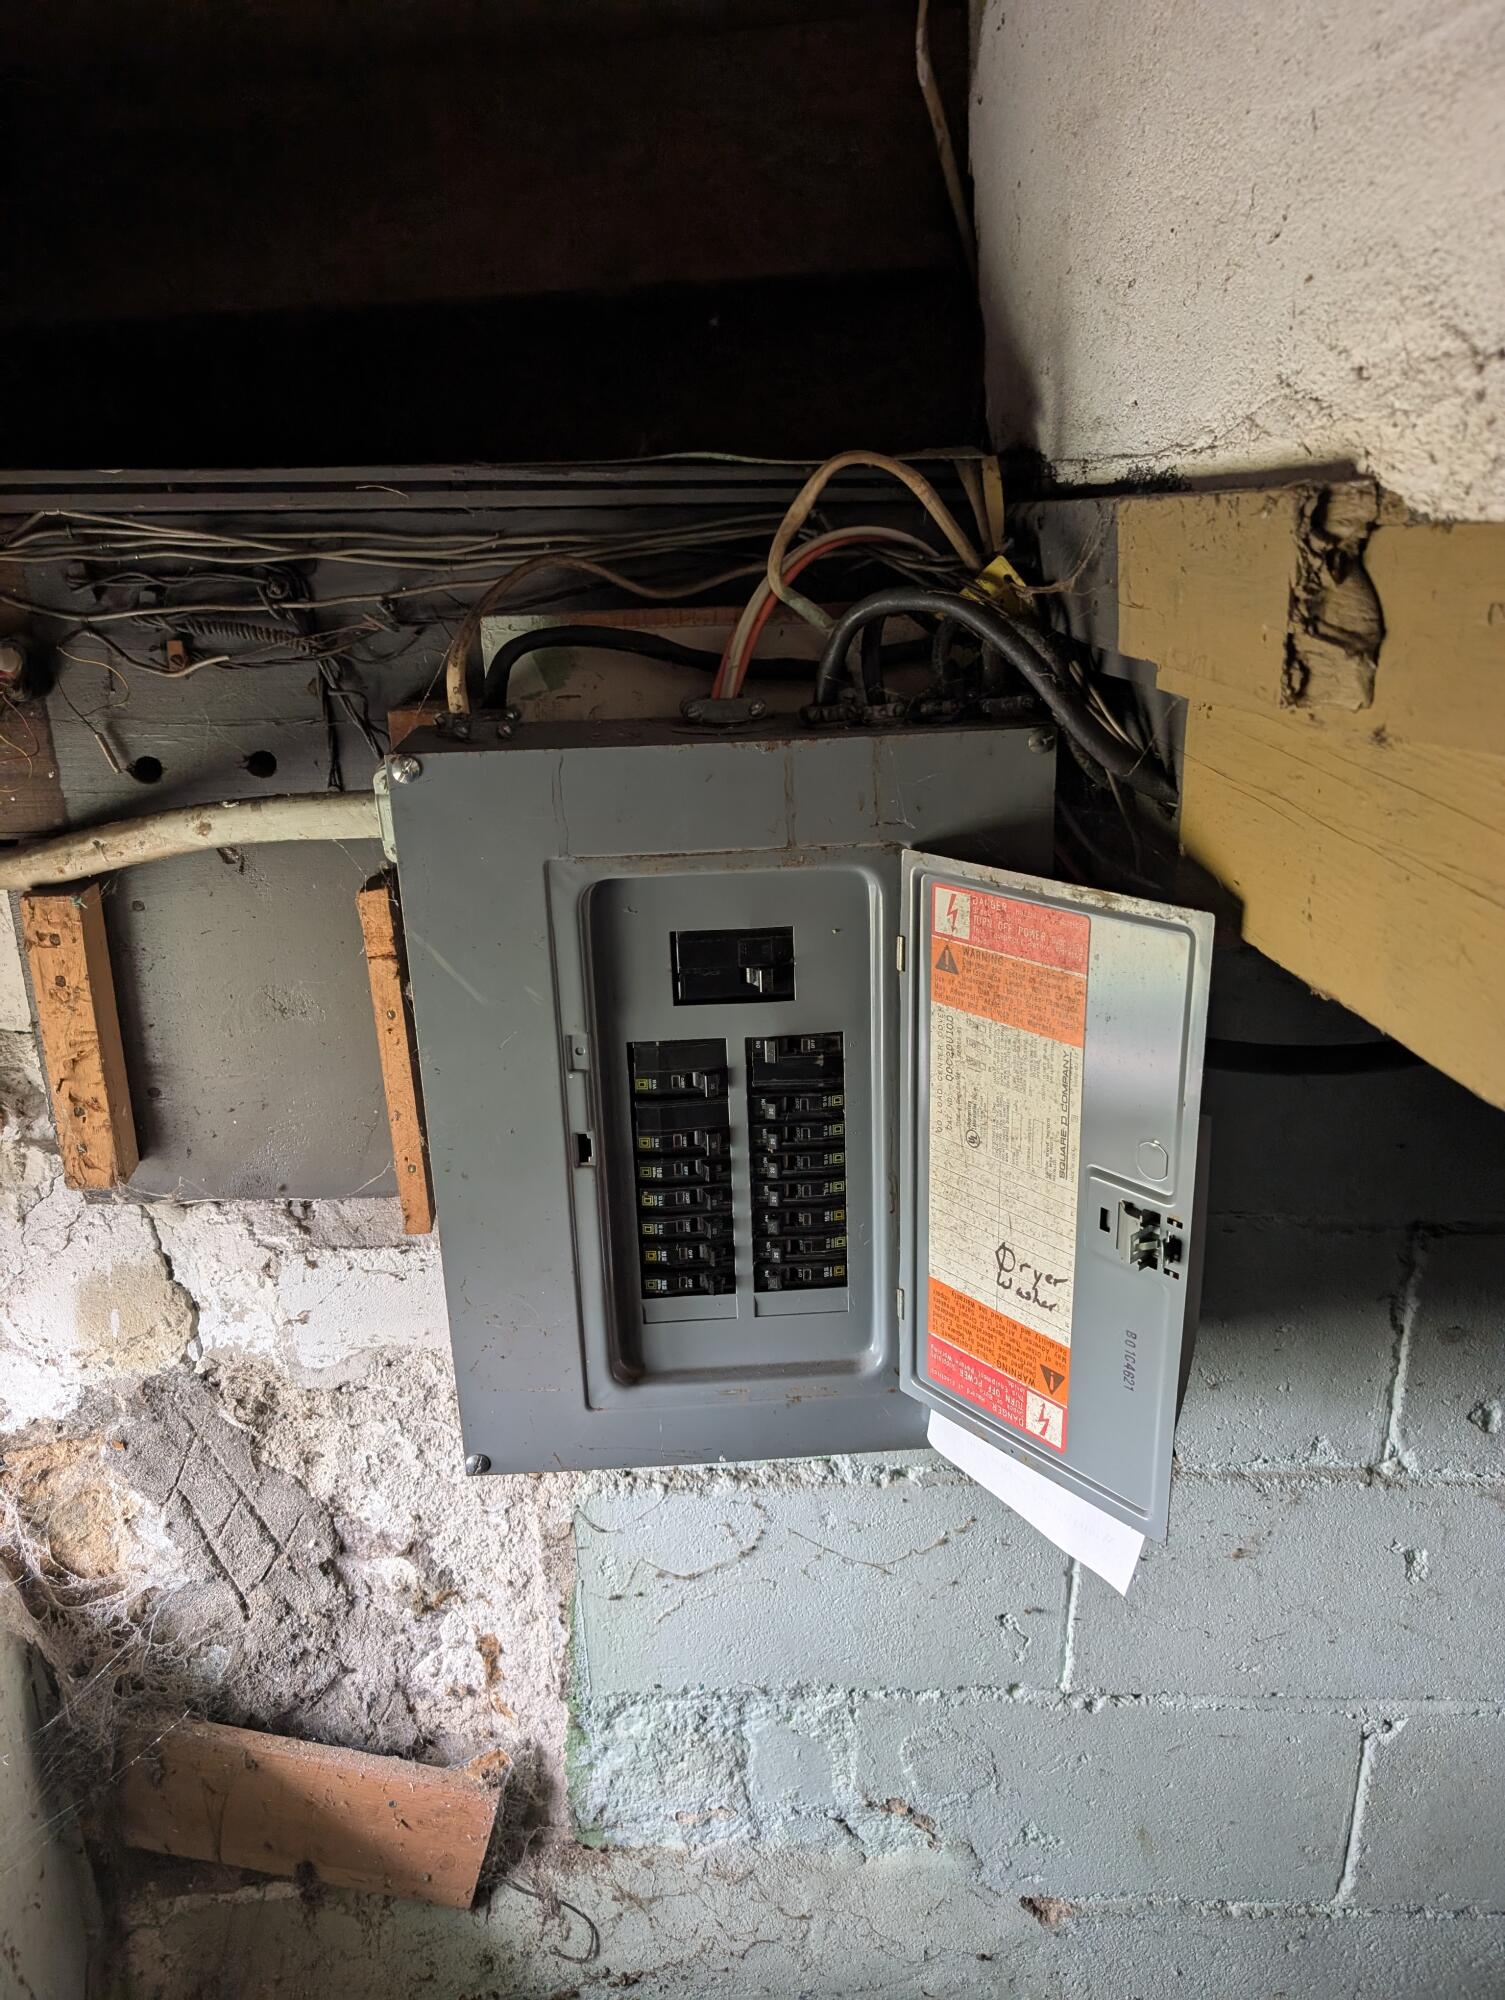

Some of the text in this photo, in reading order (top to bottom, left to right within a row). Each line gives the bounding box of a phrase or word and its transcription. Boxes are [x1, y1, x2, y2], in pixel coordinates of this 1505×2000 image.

[972, 915, 992, 928] TURN
[997, 921, 1012, 932] OFF
[1018, 926, 1046, 941] POWER
[1057, 1049, 1070, 1180] SQUARE D COMPANY
[995, 1241, 1068, 1289] Dryer
[996, 1271, 1057, 1312] Washer
[959, 1369, 983, 1387] POWER
[987, 1384, 1001, 1398] OFF
[1004, 1394, 1023, 1410] TURN
